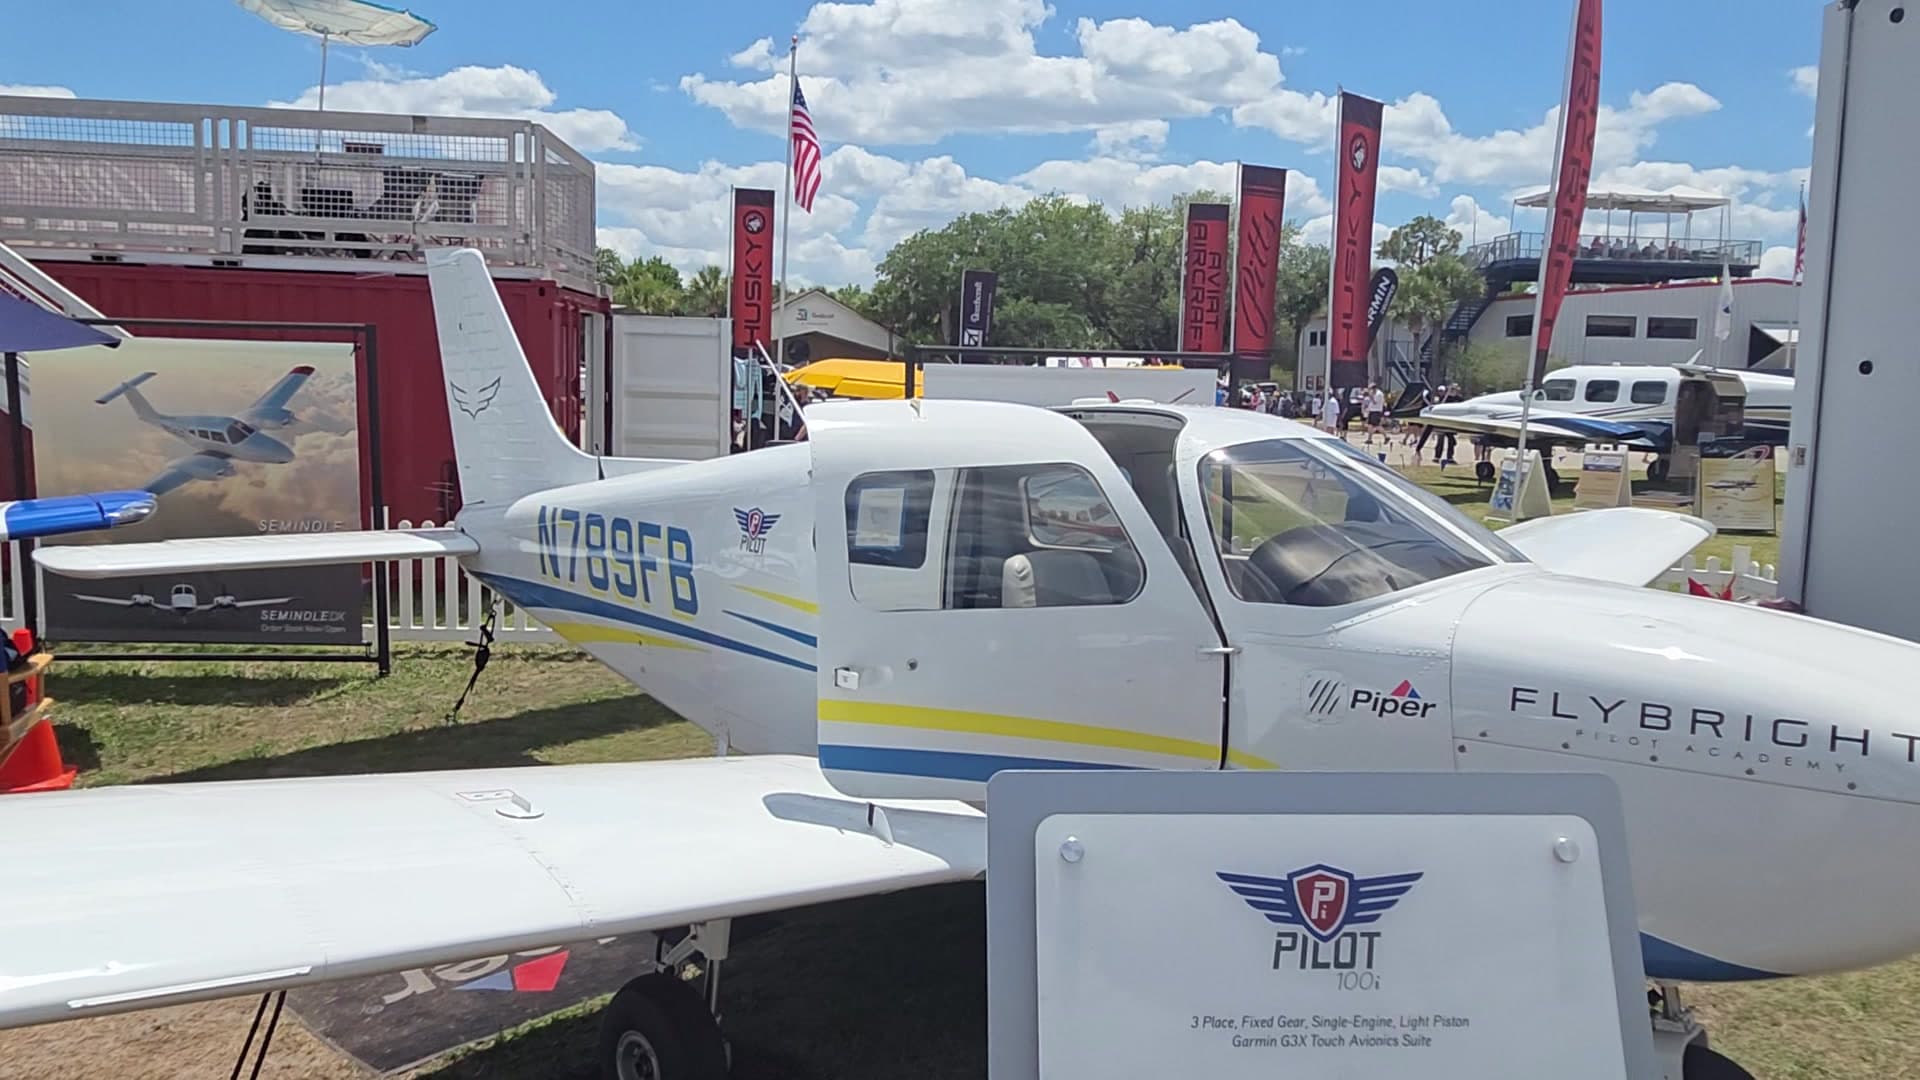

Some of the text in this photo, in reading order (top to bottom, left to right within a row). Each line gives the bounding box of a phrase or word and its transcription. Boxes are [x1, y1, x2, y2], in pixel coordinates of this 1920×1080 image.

[1205, 251, 1222, 330] AVIAT
[1342, 180, 1362, 357] HUSKY
[744, 236, 761, 347] HUSKY
[1368, 276, 1390, 327] RMIN
[538, 505, 699, 619] N789FB
[739, 535, 767, 555] PILOT
[1349, 688, 1437, 719] Piper
[1510, 687, 1920, 763] FLYBRIGHT
[1575, 729, 1846, 773] PILOT ACADEMY
[1273, 931, 1382, 970] PILOT
[1337, 971, 1381, 990] 100i
[1191, 1016, 1199, 1029] 3
[1202, 1016, 1238, 1030] Place,
[1241, 1016, 1274, 1029] Fixed
[1277, 1016, 1309, 1030] Gear,
[1399, 1016, 1429, 1031] Light
[1433, 1016, 1470, 1029] Piston
[1232, 1035, 1432, 1048] Garmin G3X Touch Avionics Suite
